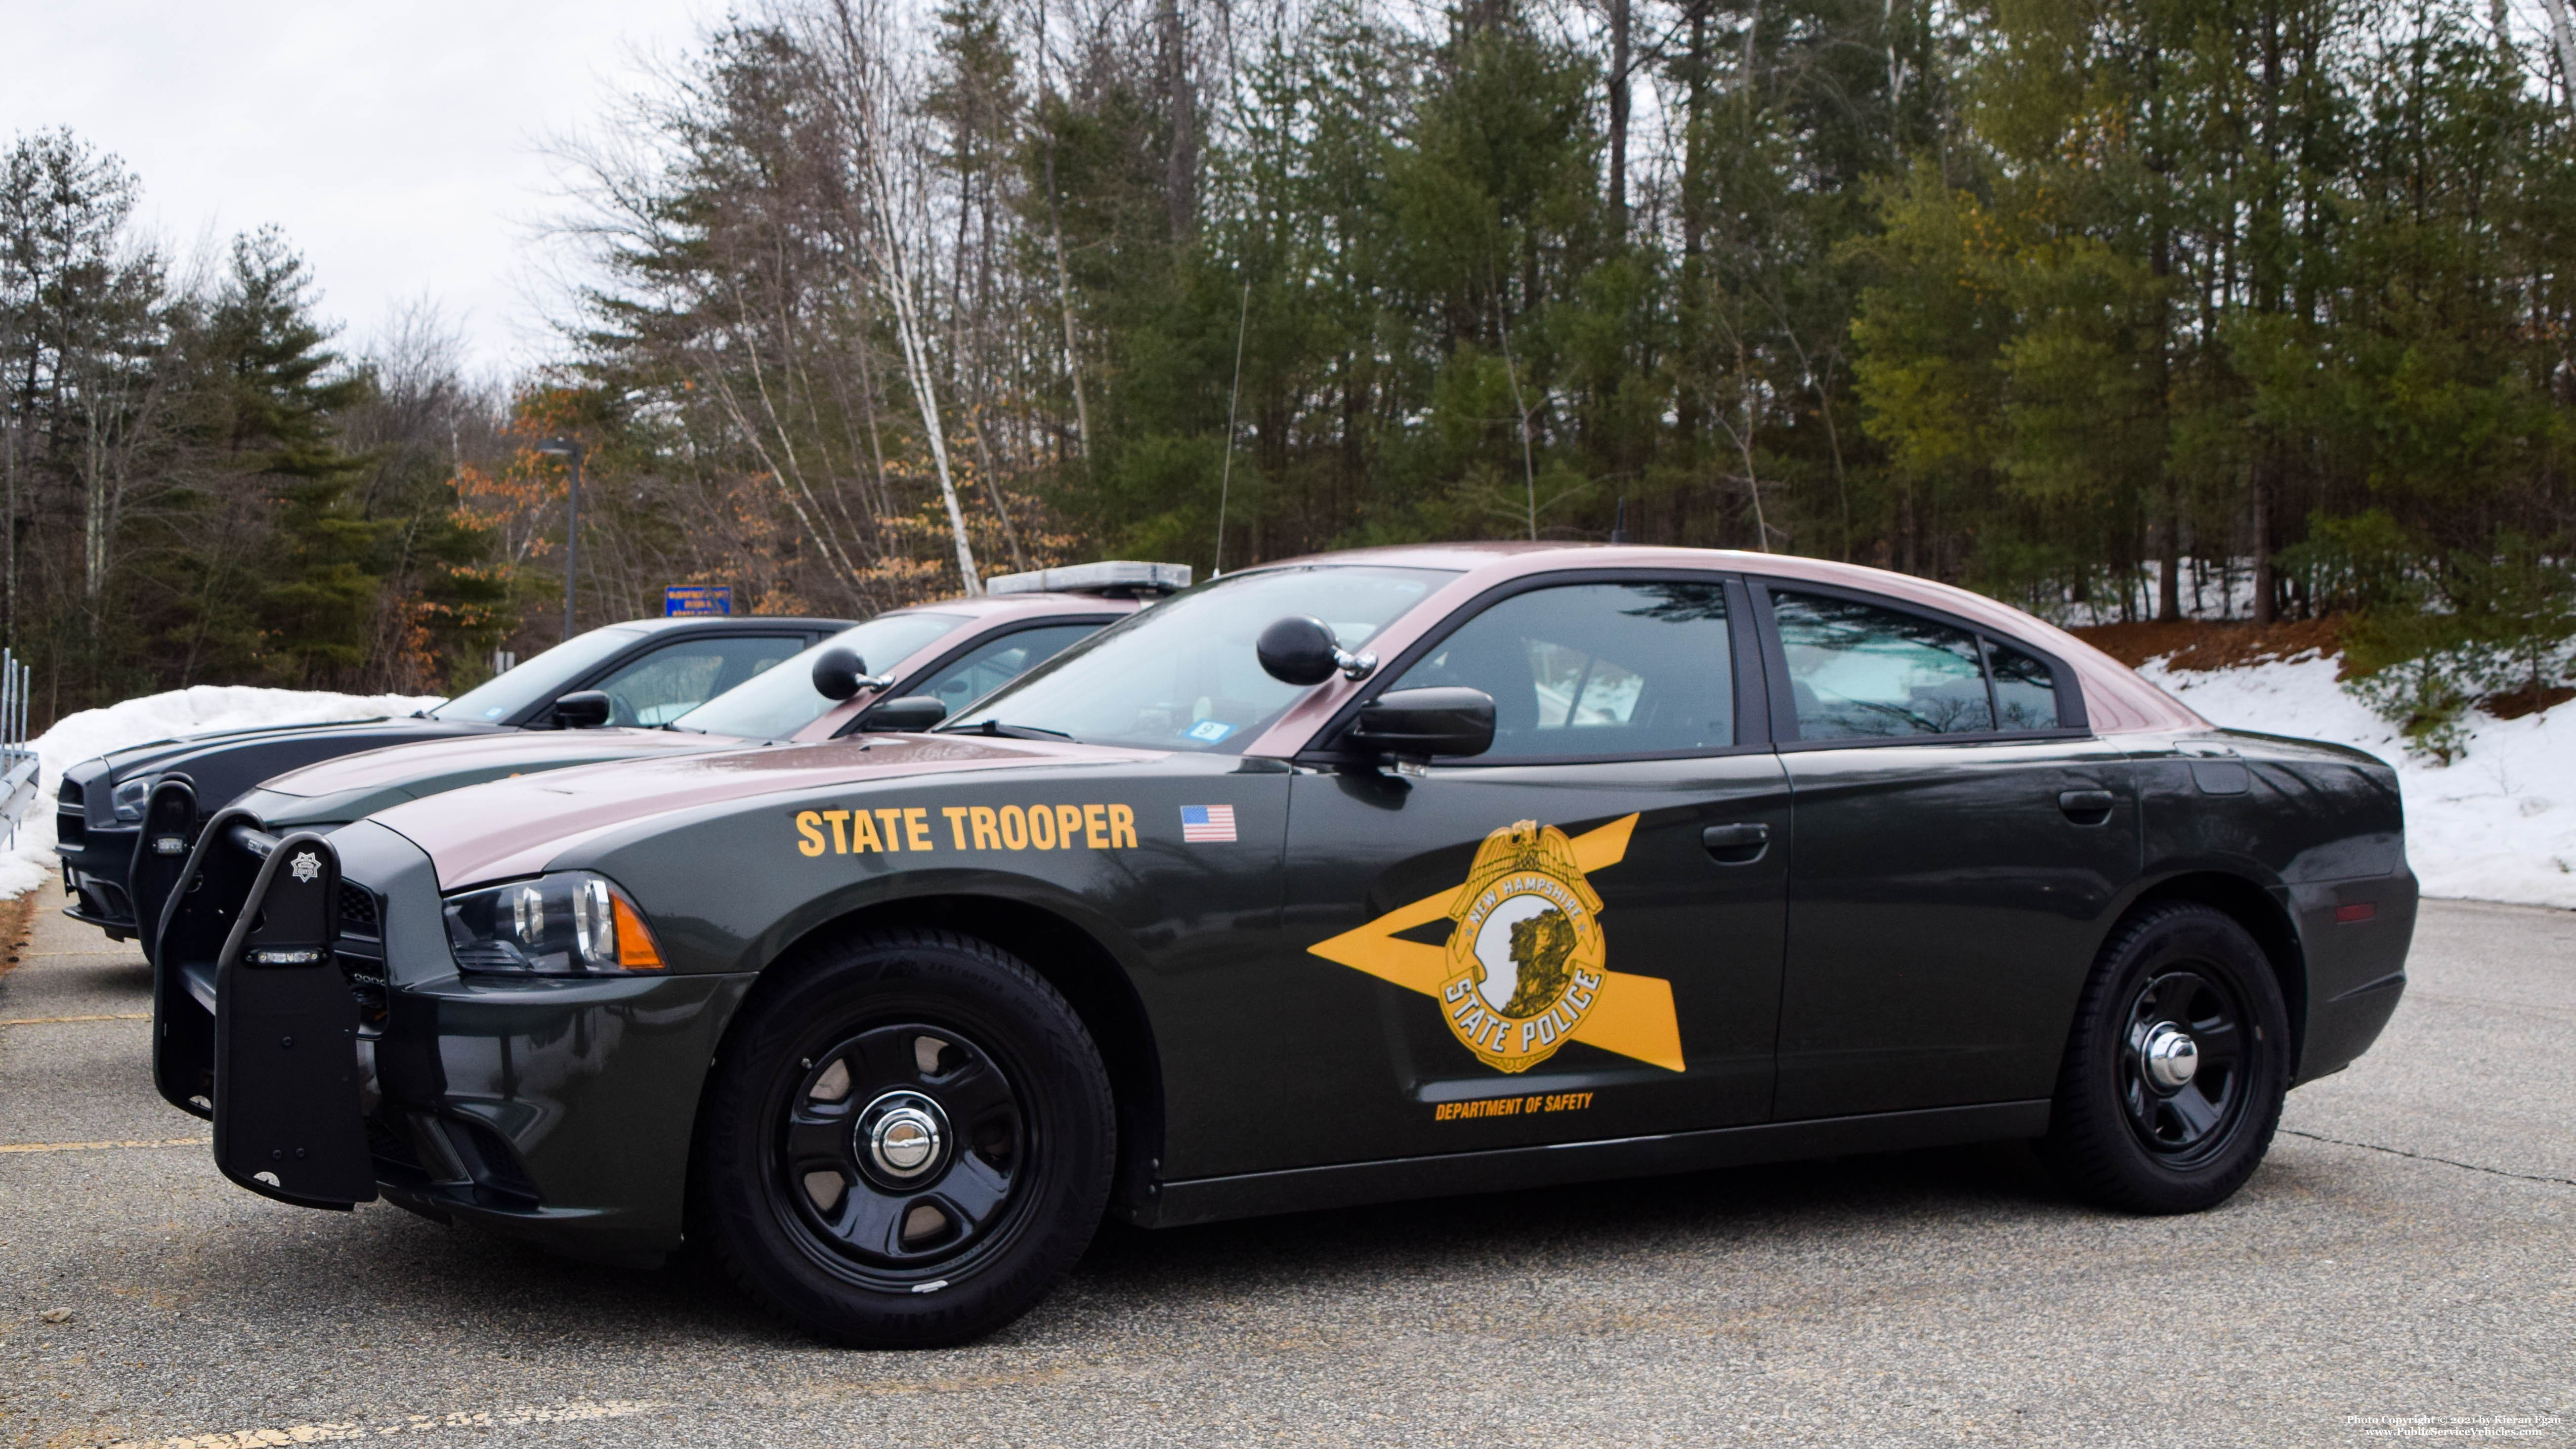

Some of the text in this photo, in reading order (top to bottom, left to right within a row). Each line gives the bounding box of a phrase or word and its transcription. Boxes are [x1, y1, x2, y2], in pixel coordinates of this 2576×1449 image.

[796, 804, 1138, 857] STATE TROOPER
[1469, 877, 1583, 925] NEW HAMPSHIRE
[354, 973, 386, 986] DODG
[1444, 967, 1602, 1052] STATE POLICE
[1435, 1092, 1594, 1121] DEPARTMENT OF SAFETY
